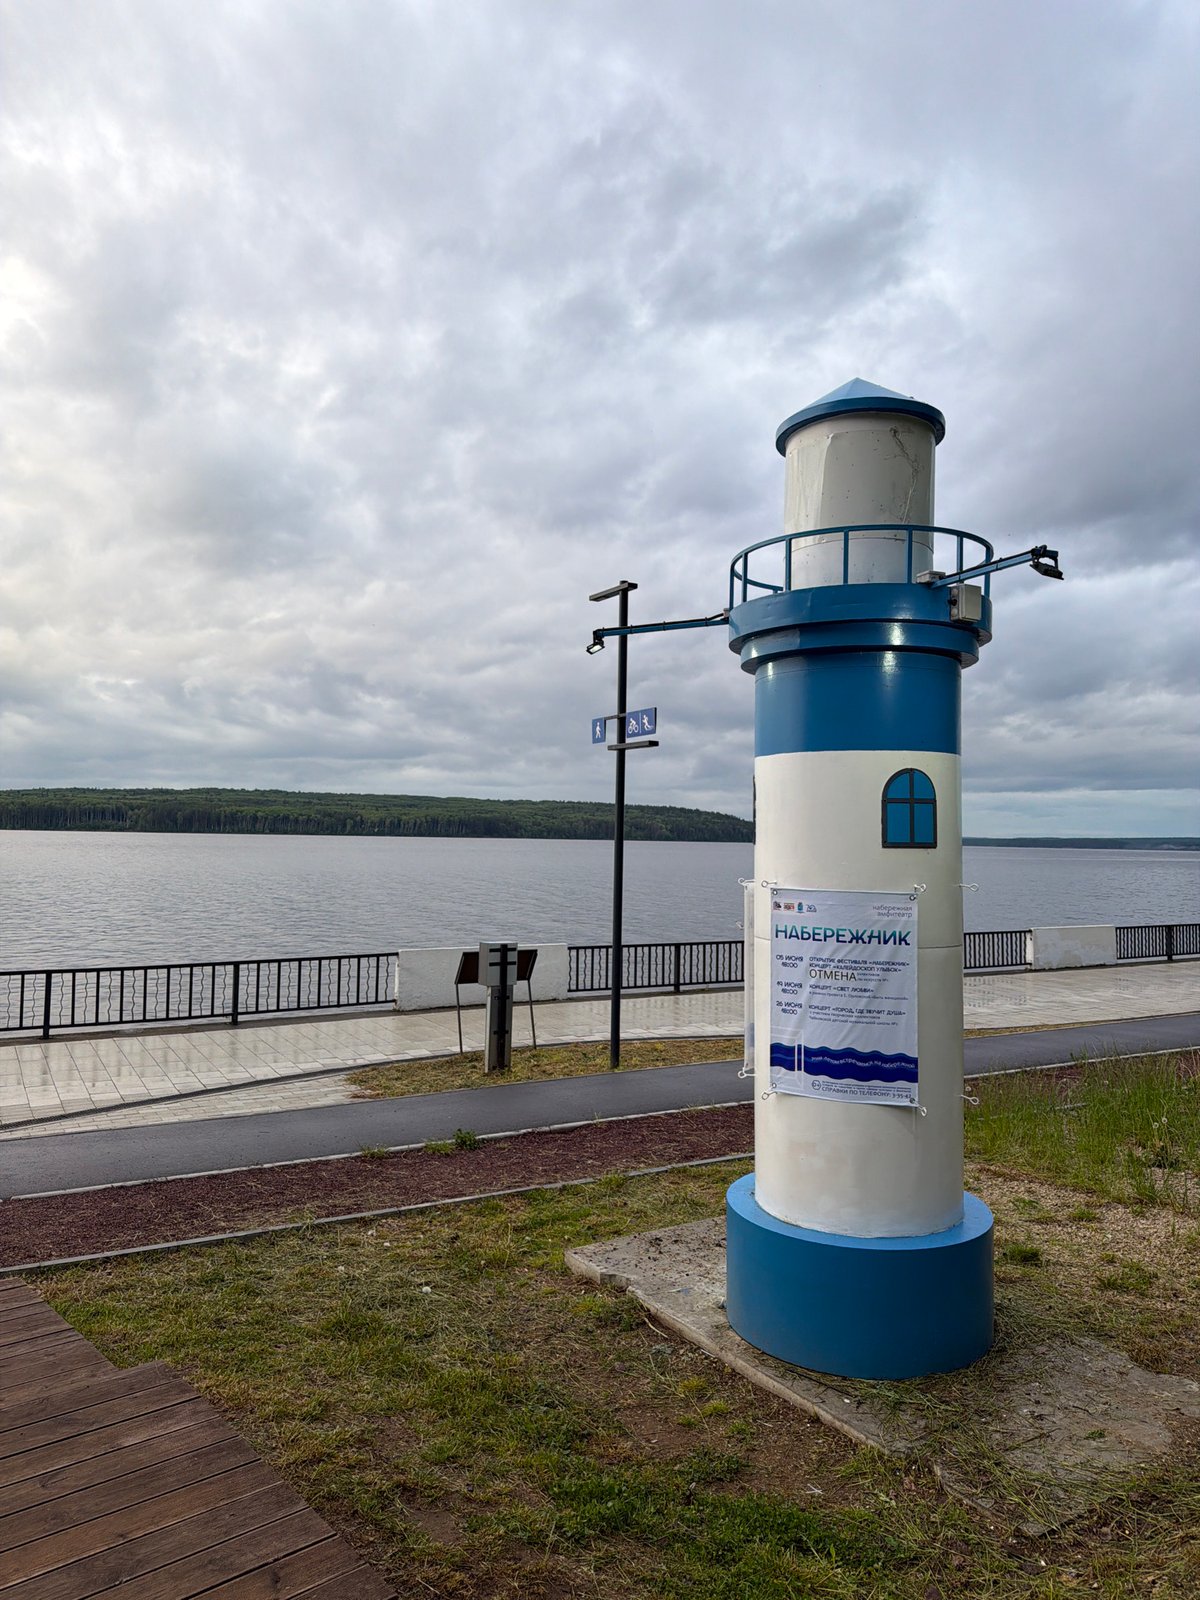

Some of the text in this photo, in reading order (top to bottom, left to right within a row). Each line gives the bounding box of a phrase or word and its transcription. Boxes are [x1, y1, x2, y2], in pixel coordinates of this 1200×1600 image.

[873, 904, 912, 912] набережная
[775, 924, 911, 946] НАБЕРЕЖНИК
[809, 968, 857, 981] ОТМЕНА
[784, 981, 803, 989] ИЮНЯ
[822, 1086, 848, 1094] СПРАВКИ
